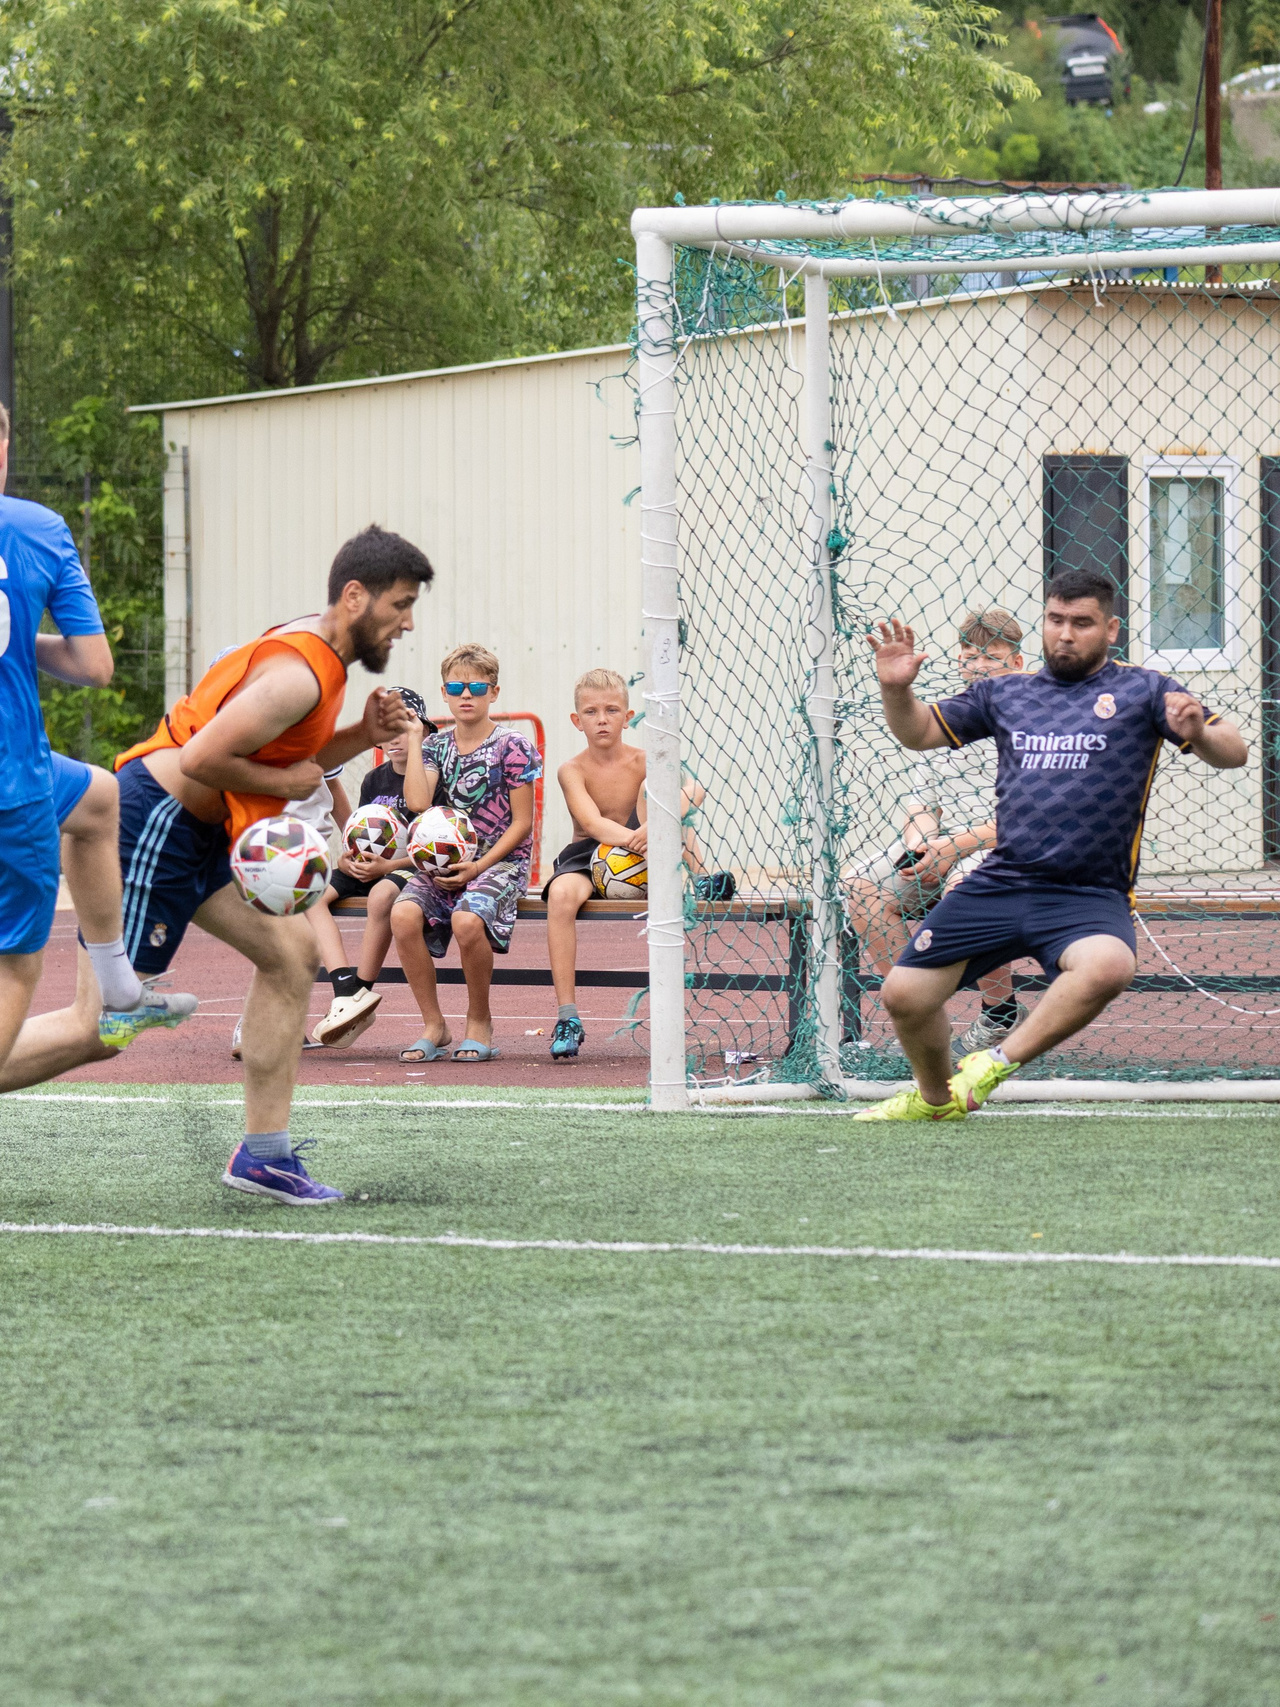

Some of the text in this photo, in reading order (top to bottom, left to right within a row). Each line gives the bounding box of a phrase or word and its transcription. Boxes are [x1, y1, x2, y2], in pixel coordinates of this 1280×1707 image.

[1011, 730, 1107, 751] Emirates
[1021, 753, 1090, 769] FLY BETTER
